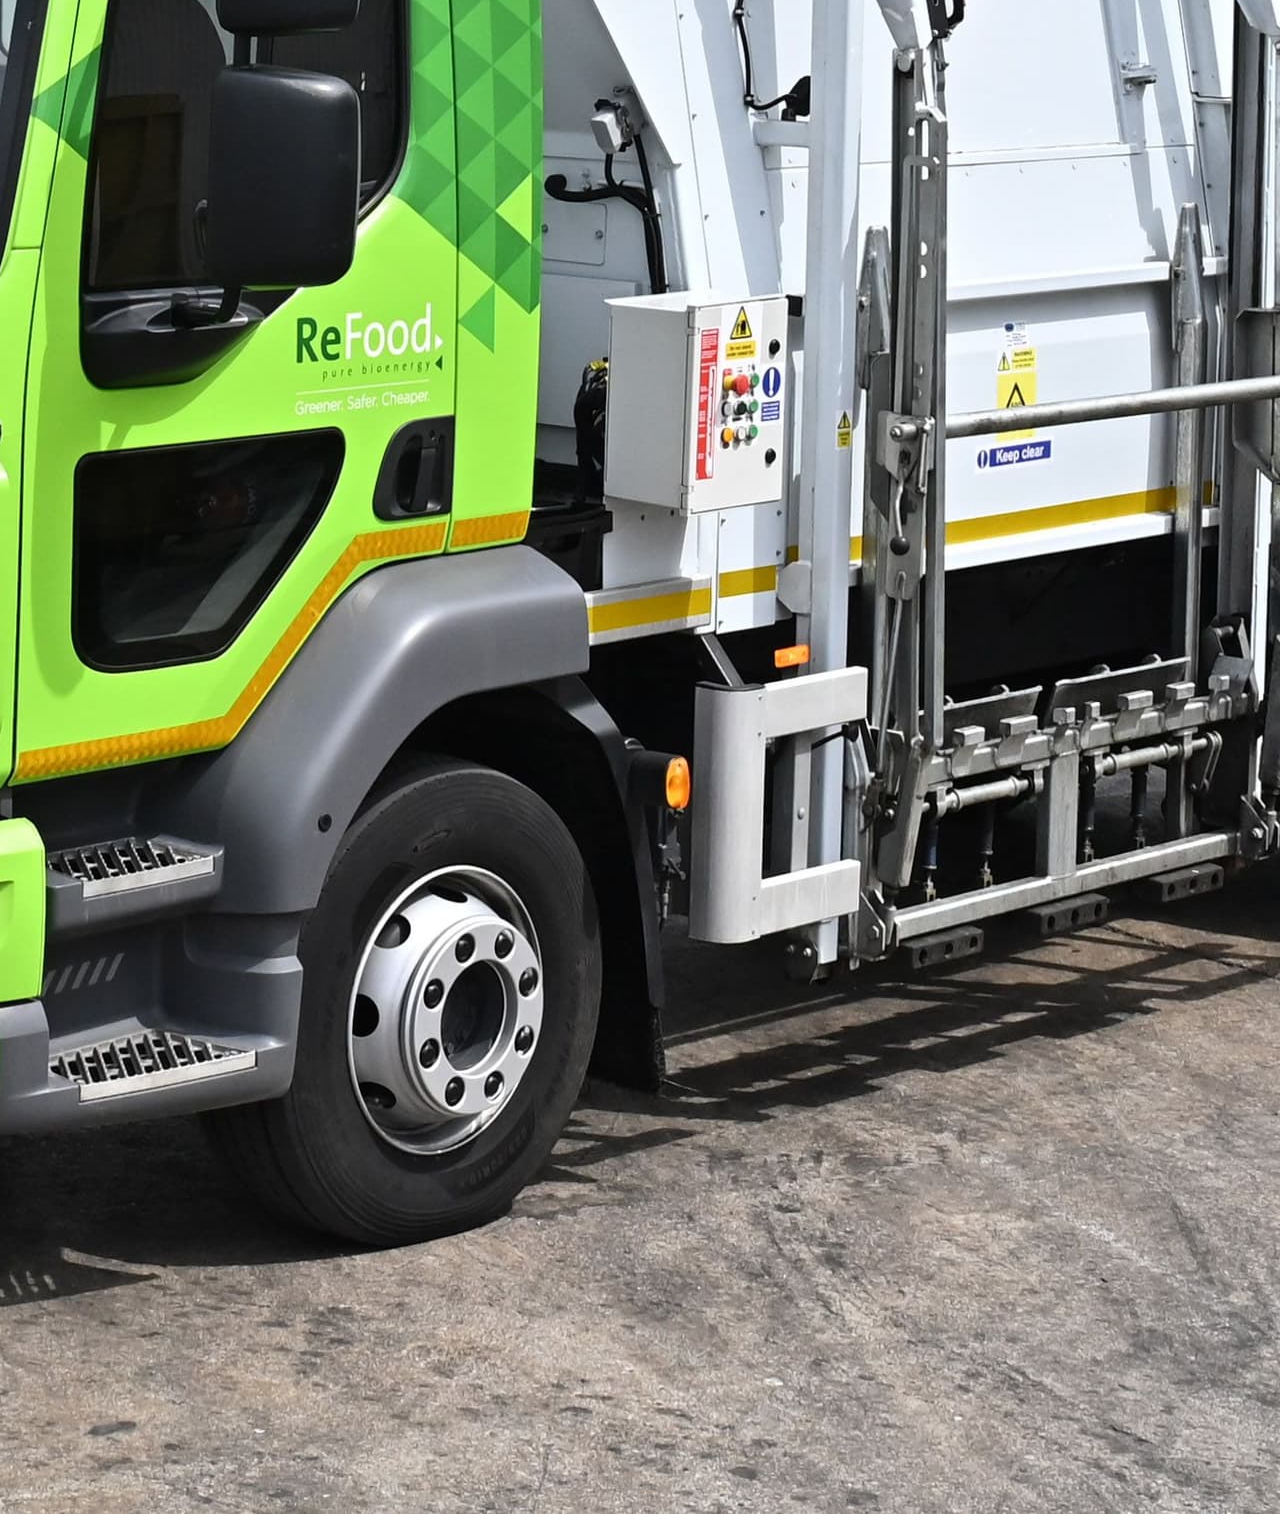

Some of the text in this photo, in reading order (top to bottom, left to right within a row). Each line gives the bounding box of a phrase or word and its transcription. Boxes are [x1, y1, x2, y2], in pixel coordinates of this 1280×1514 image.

[296, 302, 432, 364] ReFood
[322, 360, 431, 382] pure bioenergy
[295, 390, 430, 415] Greener. Safer. Cheaper.
[995, 443, 1045, 464] Keep clear
